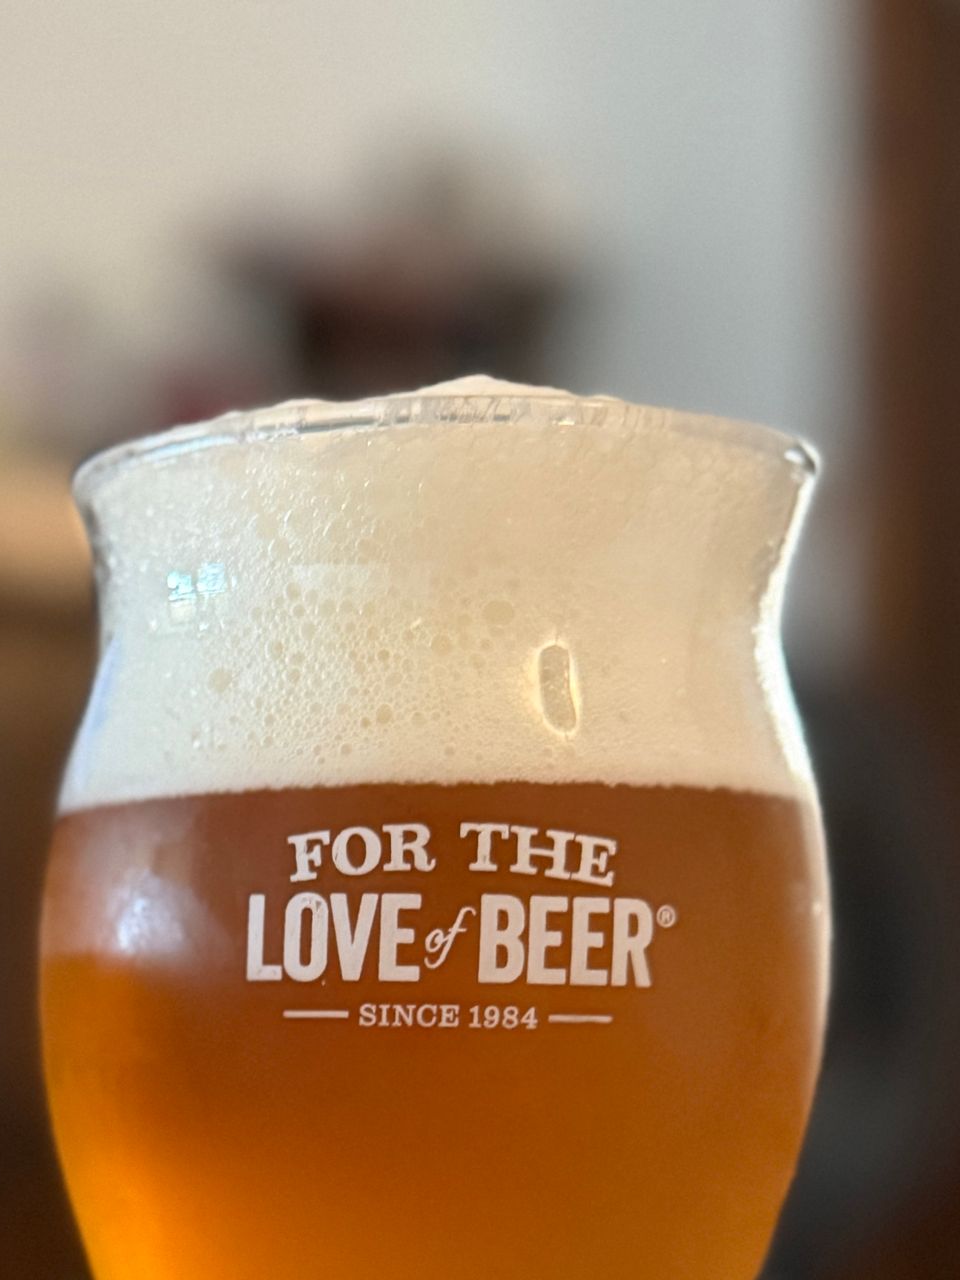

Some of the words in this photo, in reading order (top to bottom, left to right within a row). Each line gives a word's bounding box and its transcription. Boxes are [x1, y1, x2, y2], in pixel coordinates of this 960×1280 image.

[287, 823, 436, 882] FOR
[459, 822, 617, 886] THE
[246, 891, 422, 982] LOVE
[424, 905, 476, 969] of
[358, 1003, 460, 1028] SINCE
[468, 1005, 539, 1030] 1984
